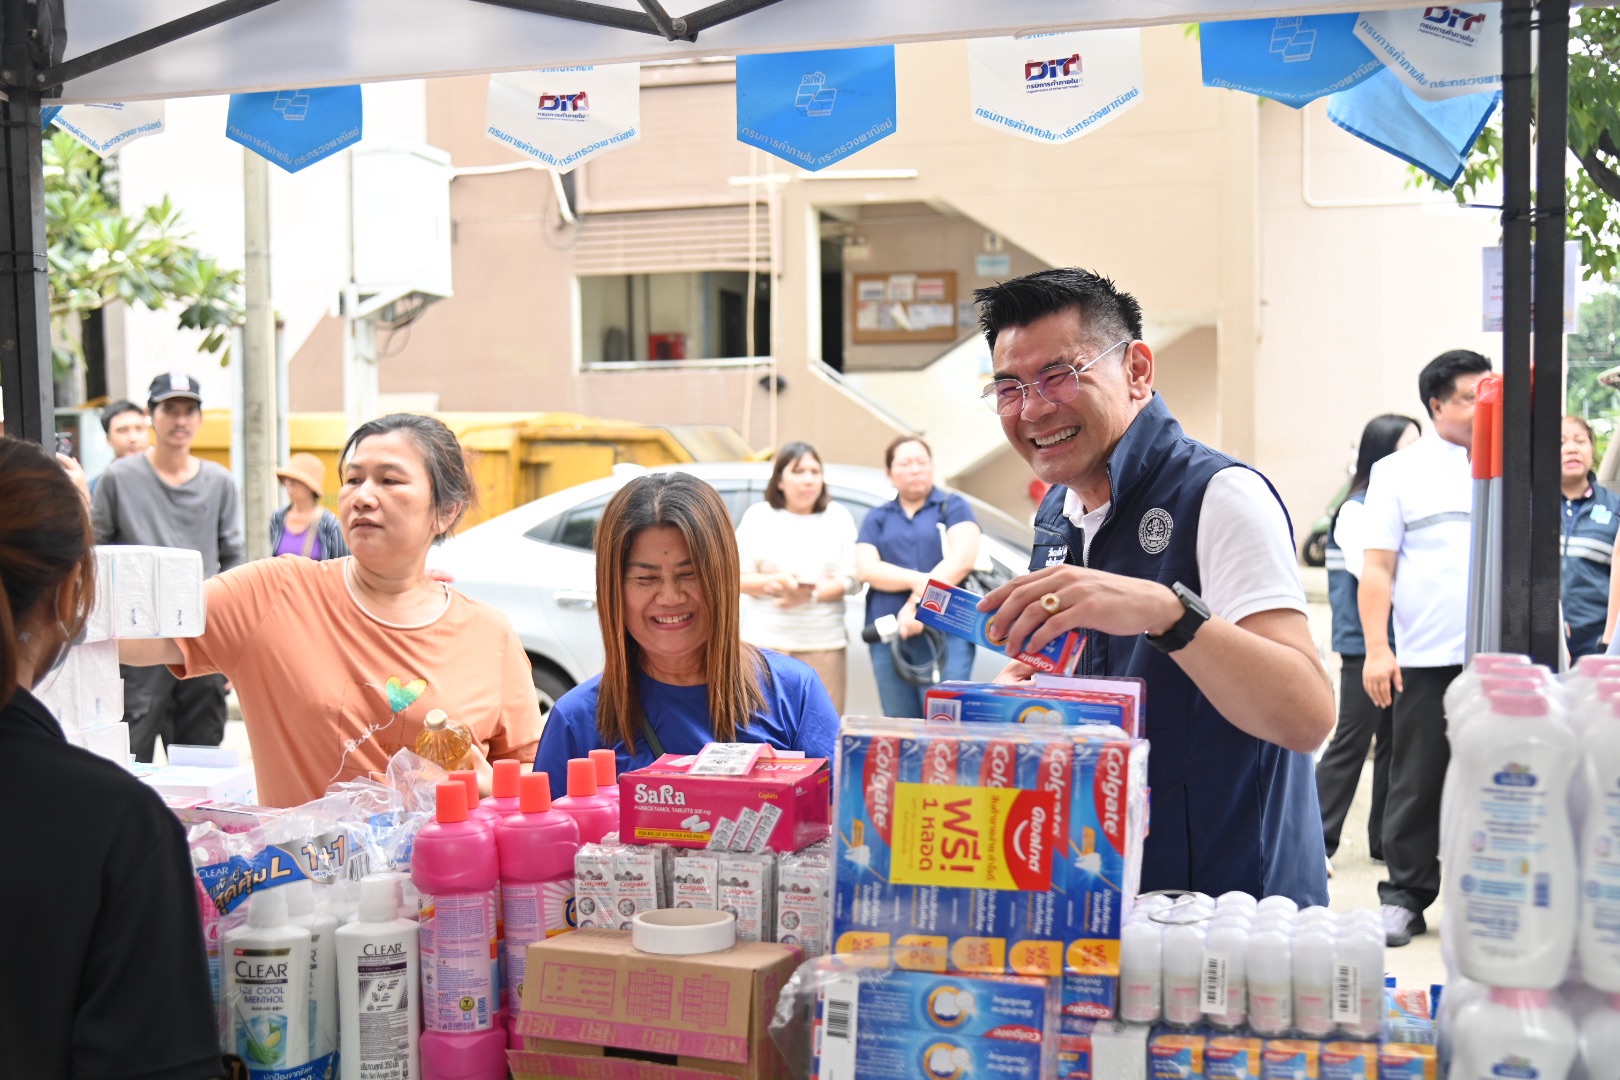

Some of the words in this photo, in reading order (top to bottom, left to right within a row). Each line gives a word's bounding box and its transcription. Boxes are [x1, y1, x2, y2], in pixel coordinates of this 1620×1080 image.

[1359, 20, 1429, 86] กรมการค้าภายใน
[229, 124, 293, 166] กรมการค้าภายใน
[294, 126, 360, 166] กระทรวงพาณิชย์
[741, 127, 816, 165] กรมการค้าภายใน
[817, 117, 893, 165] กระทรวงพาณิชย์
[870, 739, 894, 829] Colgate
[929, 743, 952, 785] Colg
[987, 745, 1009, 788] Colg
[634, 783, 686, 806] SaRa
[922, 798, 938, 810] 1
[1101, 748, 1124, 835] Colgate
[301, 834, 346, 872] 1+1
[919, 817, 936, 871] หลอด
[940, 798, 982, 873] ฟรี!
[198, 867, 229, 878] CLEAR
[235, 960, 288, 978] CLEAR
[363, 943, 402, 956] CLEAR
[244, 995, 285, 1004] MENTHOL
[256, 986, 285, 995] COOL
[993, 1028, 1041, 1041] Colgate
